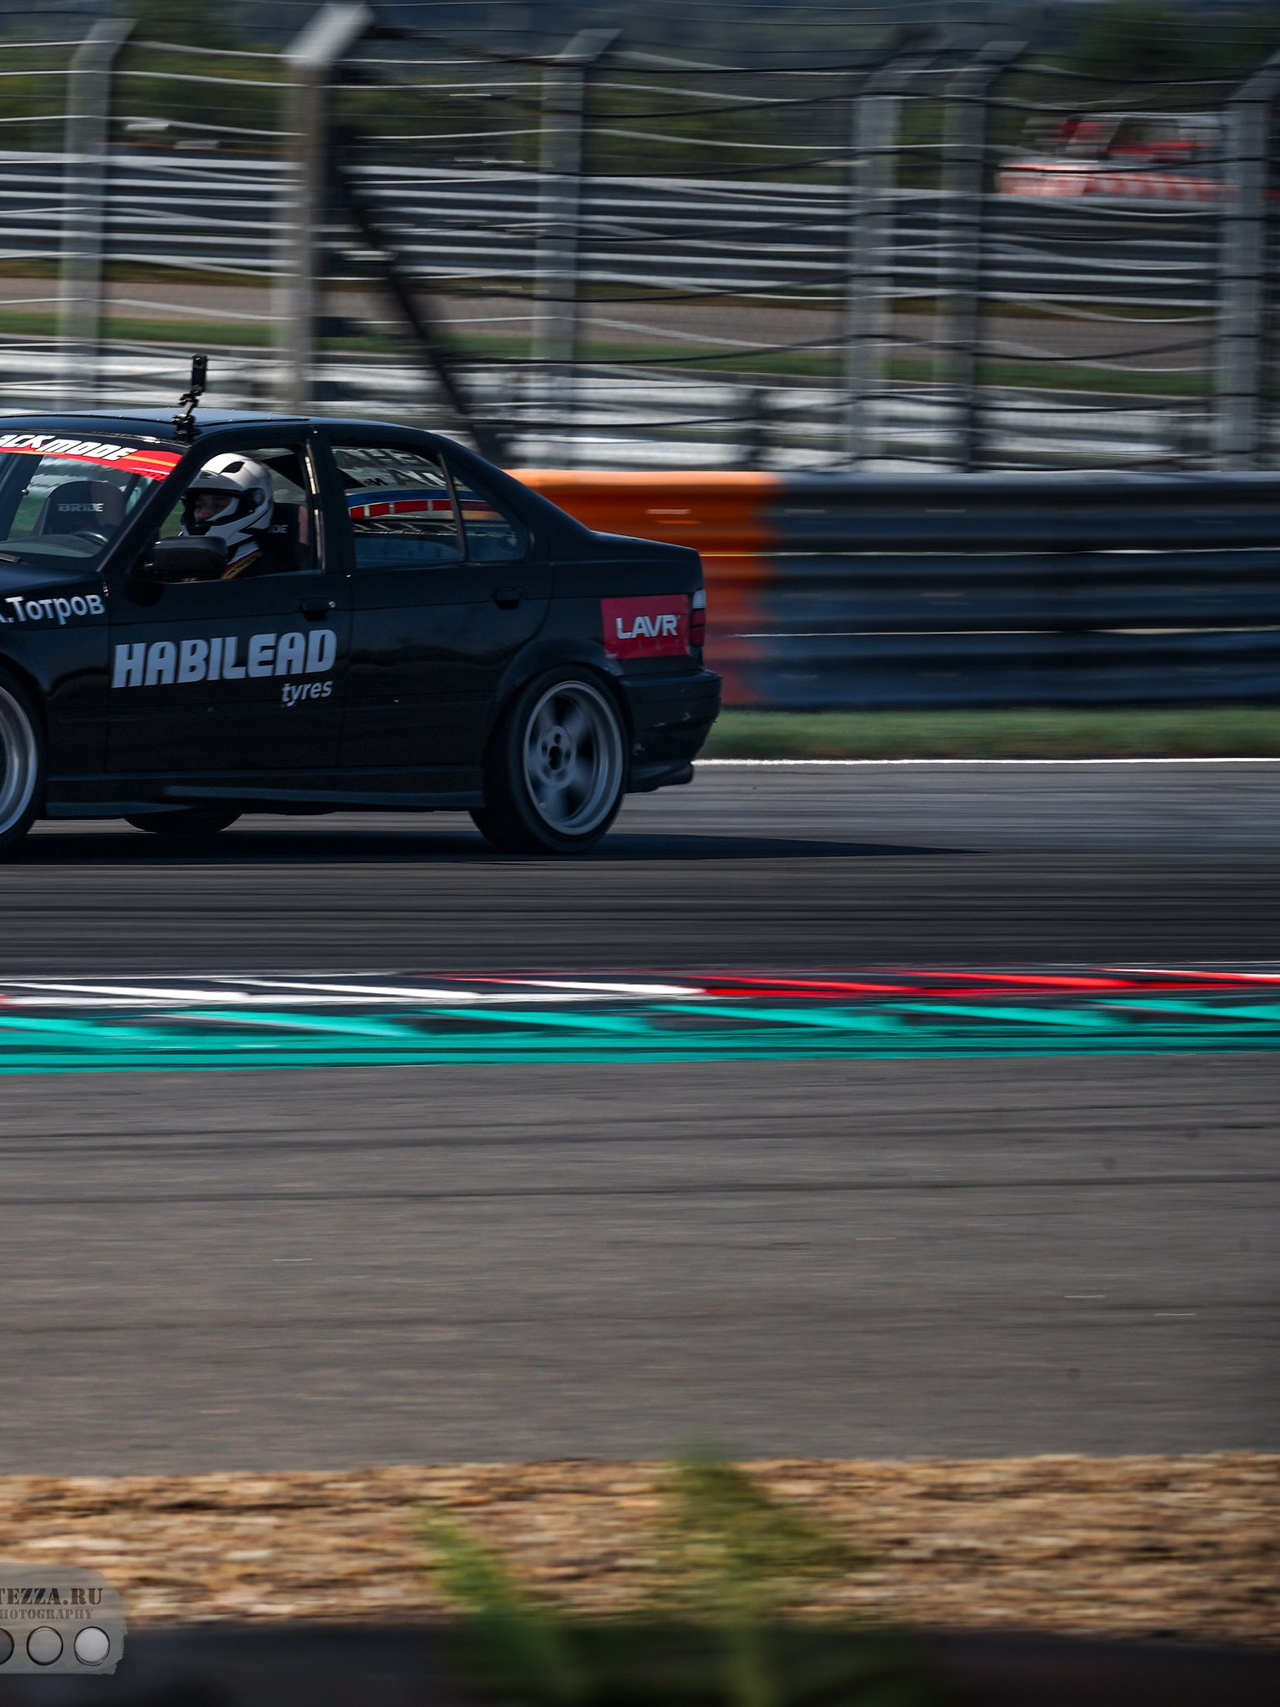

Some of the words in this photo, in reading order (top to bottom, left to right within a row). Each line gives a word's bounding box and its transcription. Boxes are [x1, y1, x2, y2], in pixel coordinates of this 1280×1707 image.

[57, 502, 104, 512] BRIDE
[616, 614, 678, 639] LAVR
[111, 629, 337, 688] HABILEAD
[281, 680, 333, 706] tyres
